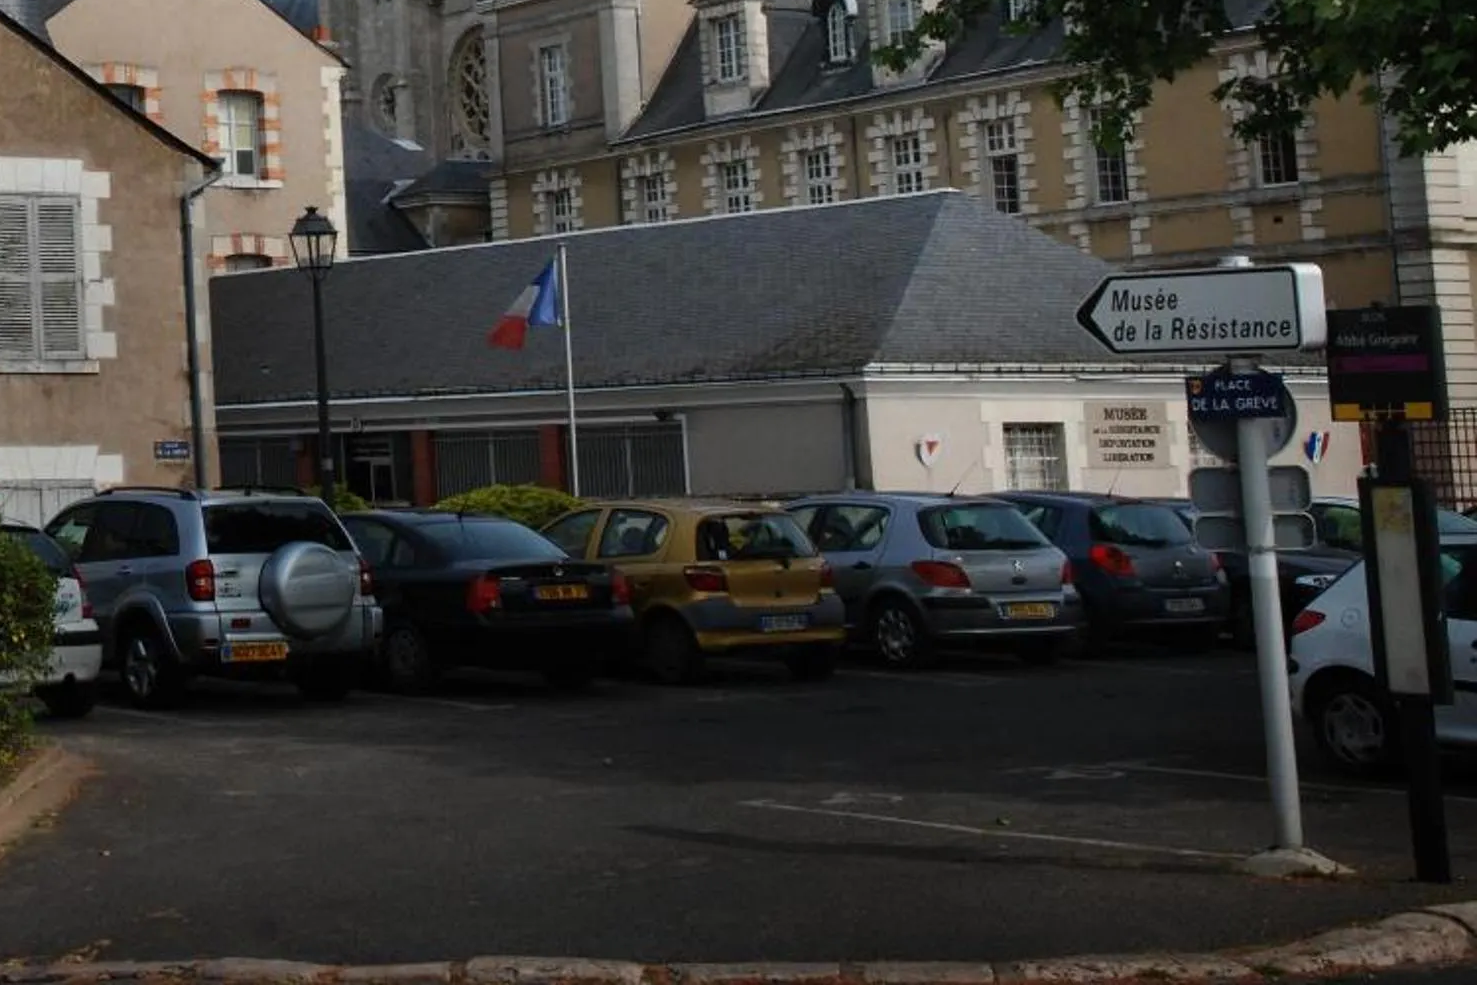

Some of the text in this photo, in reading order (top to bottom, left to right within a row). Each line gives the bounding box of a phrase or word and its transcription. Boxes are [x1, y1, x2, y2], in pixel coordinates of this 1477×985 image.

[1111, 288, 1179, 312] Musée
[1114, 317, 1292, 342] de la Résistance
[1214, 379, 1252, 391] PLACE
[1191, 398, 1208, 411] DE
[1213, 397, 1230, 410] LA
